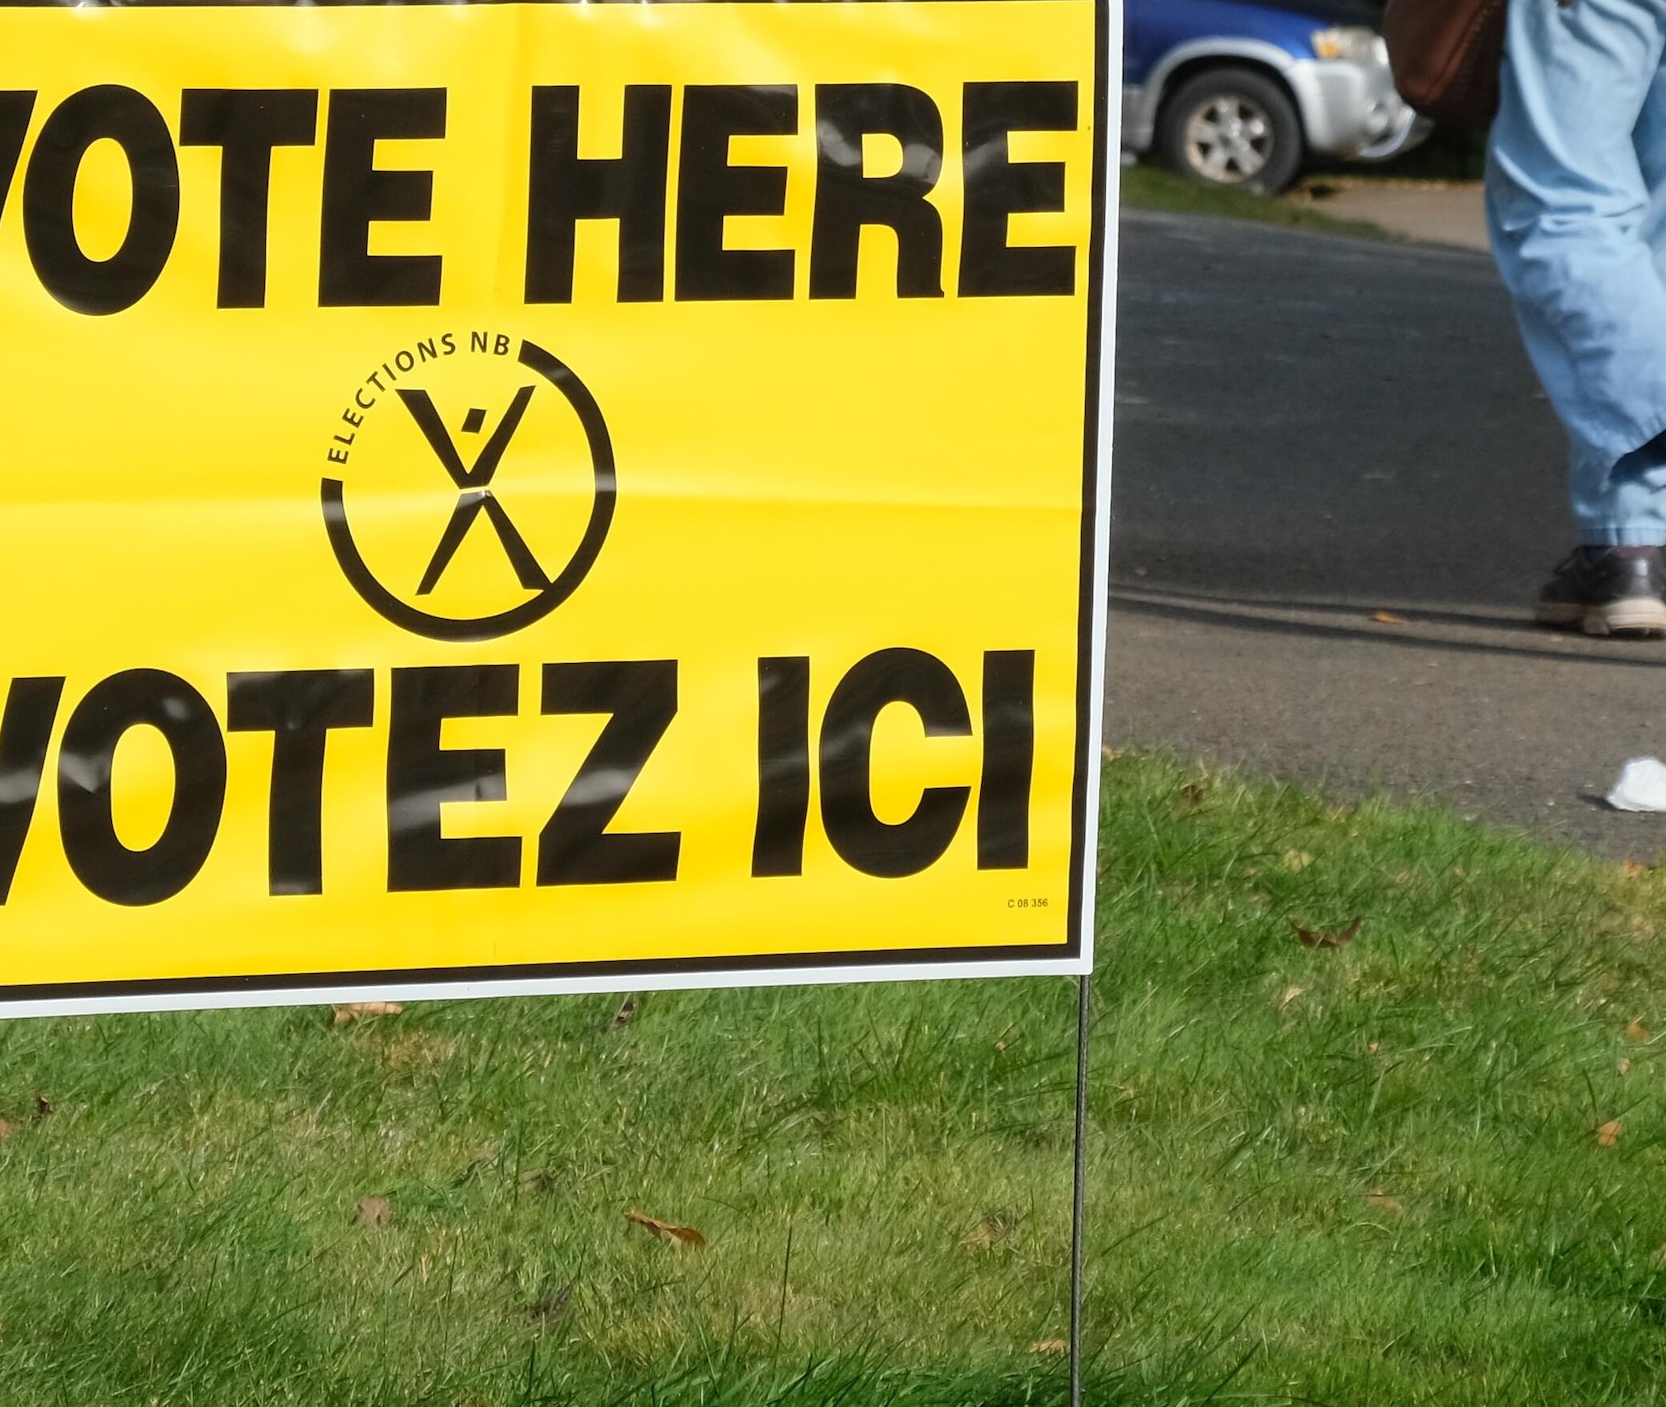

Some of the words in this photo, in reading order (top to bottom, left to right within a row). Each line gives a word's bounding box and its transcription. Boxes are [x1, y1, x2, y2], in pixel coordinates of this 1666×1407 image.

[525, 81, 1079, 304] HERE
[327, 332, 456, 465] ELECTIONS
[470, 331, 511, 356] NB
[752, 648, 1035, 878] ICI
[1007, 898, 1015, 909] C
